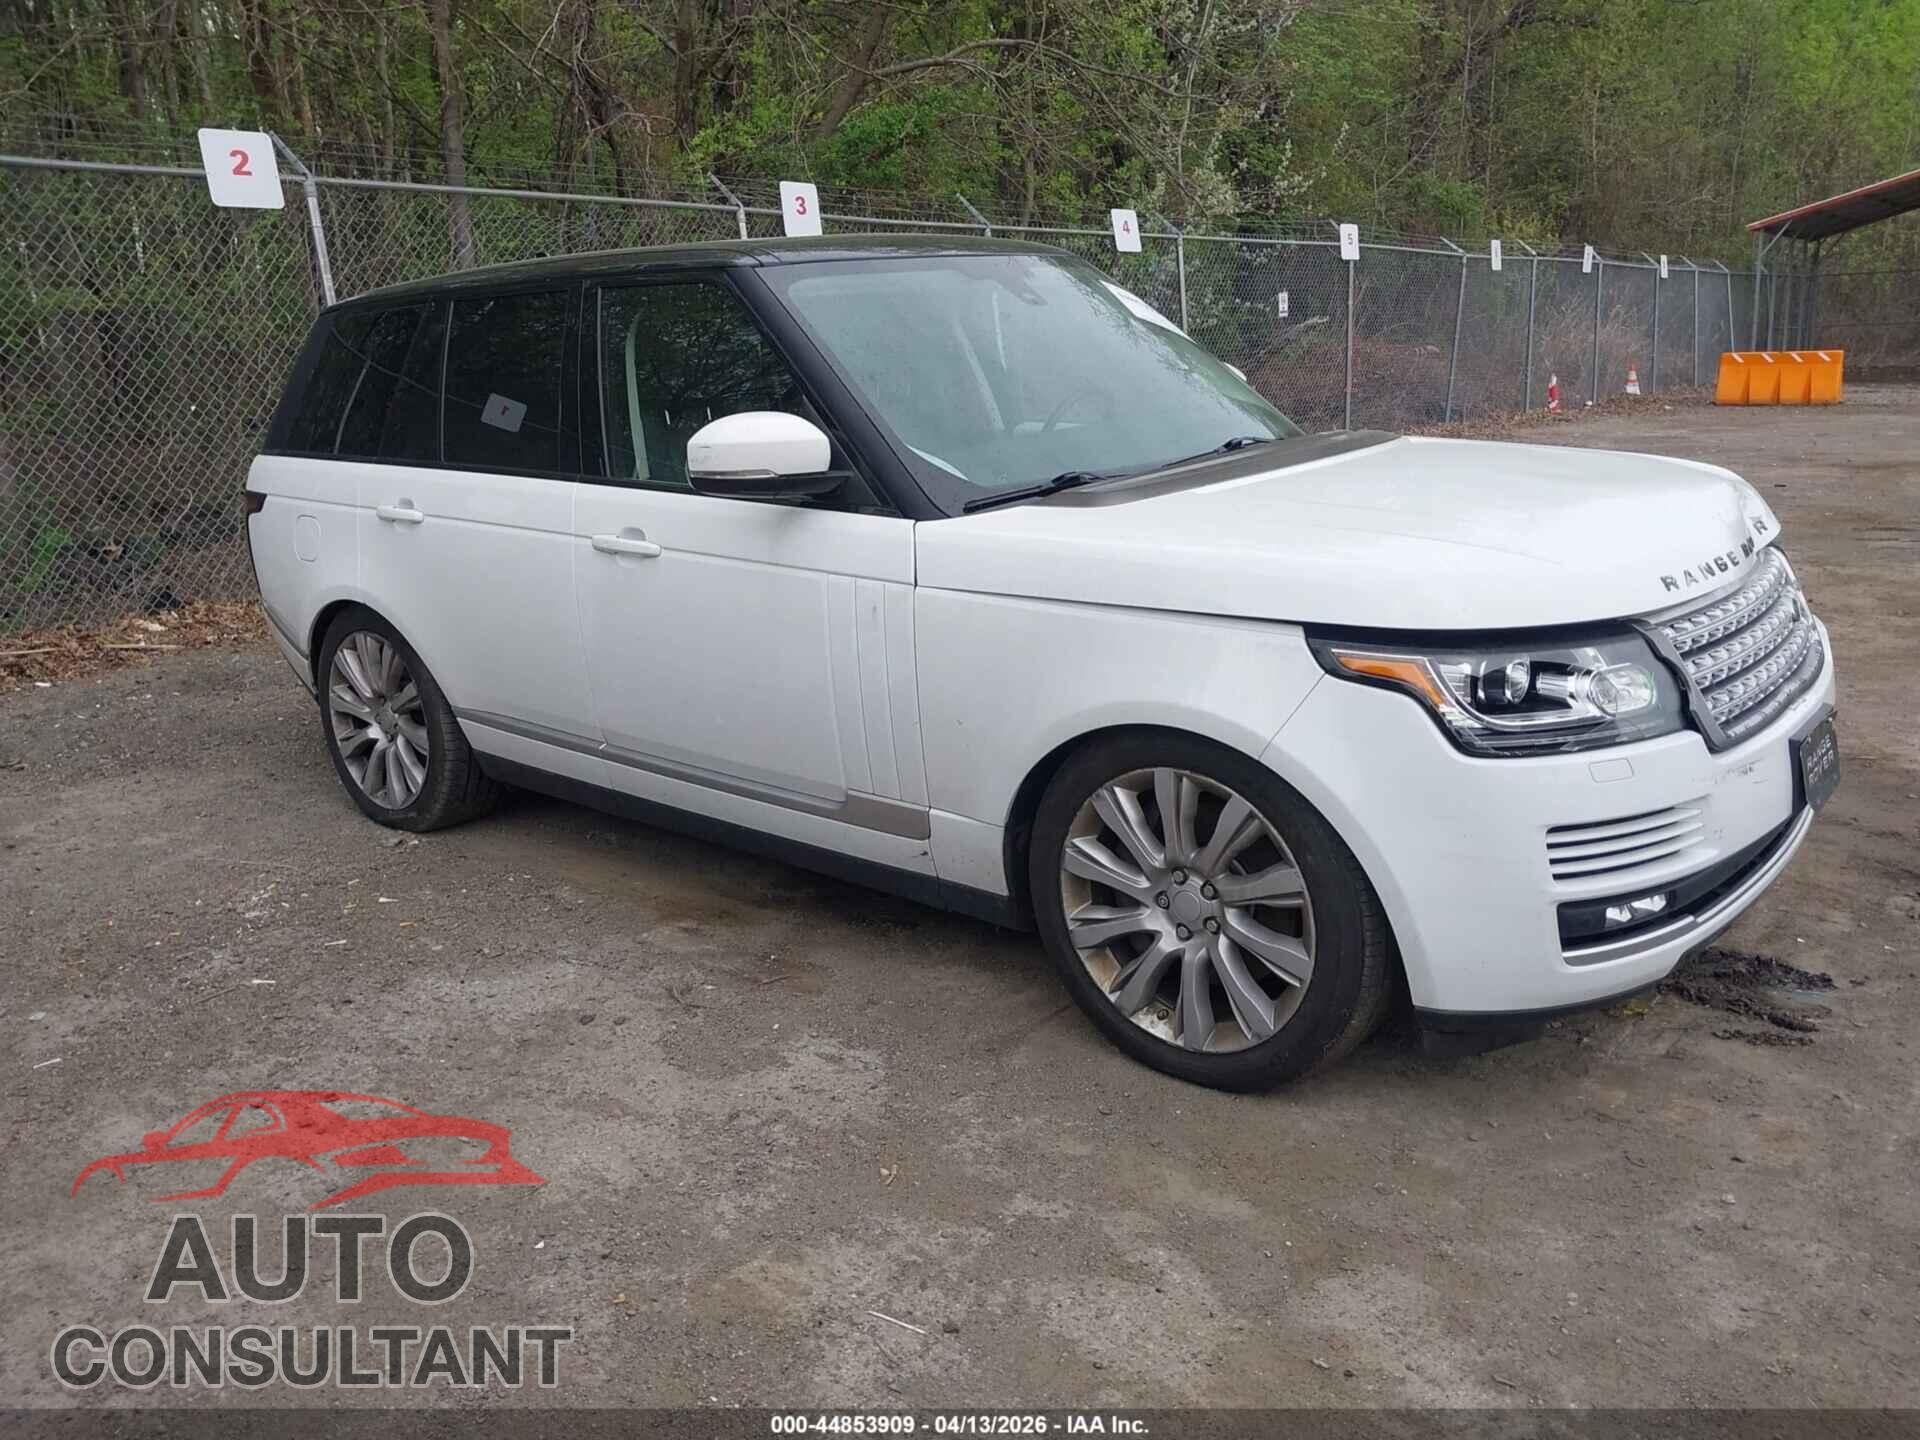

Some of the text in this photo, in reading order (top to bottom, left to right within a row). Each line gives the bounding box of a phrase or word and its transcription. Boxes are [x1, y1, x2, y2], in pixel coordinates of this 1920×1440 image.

[229, 149, 253, 176] 2
[795, 196, 807, 215] 3
[1122, 220, 1130, 234] 4
